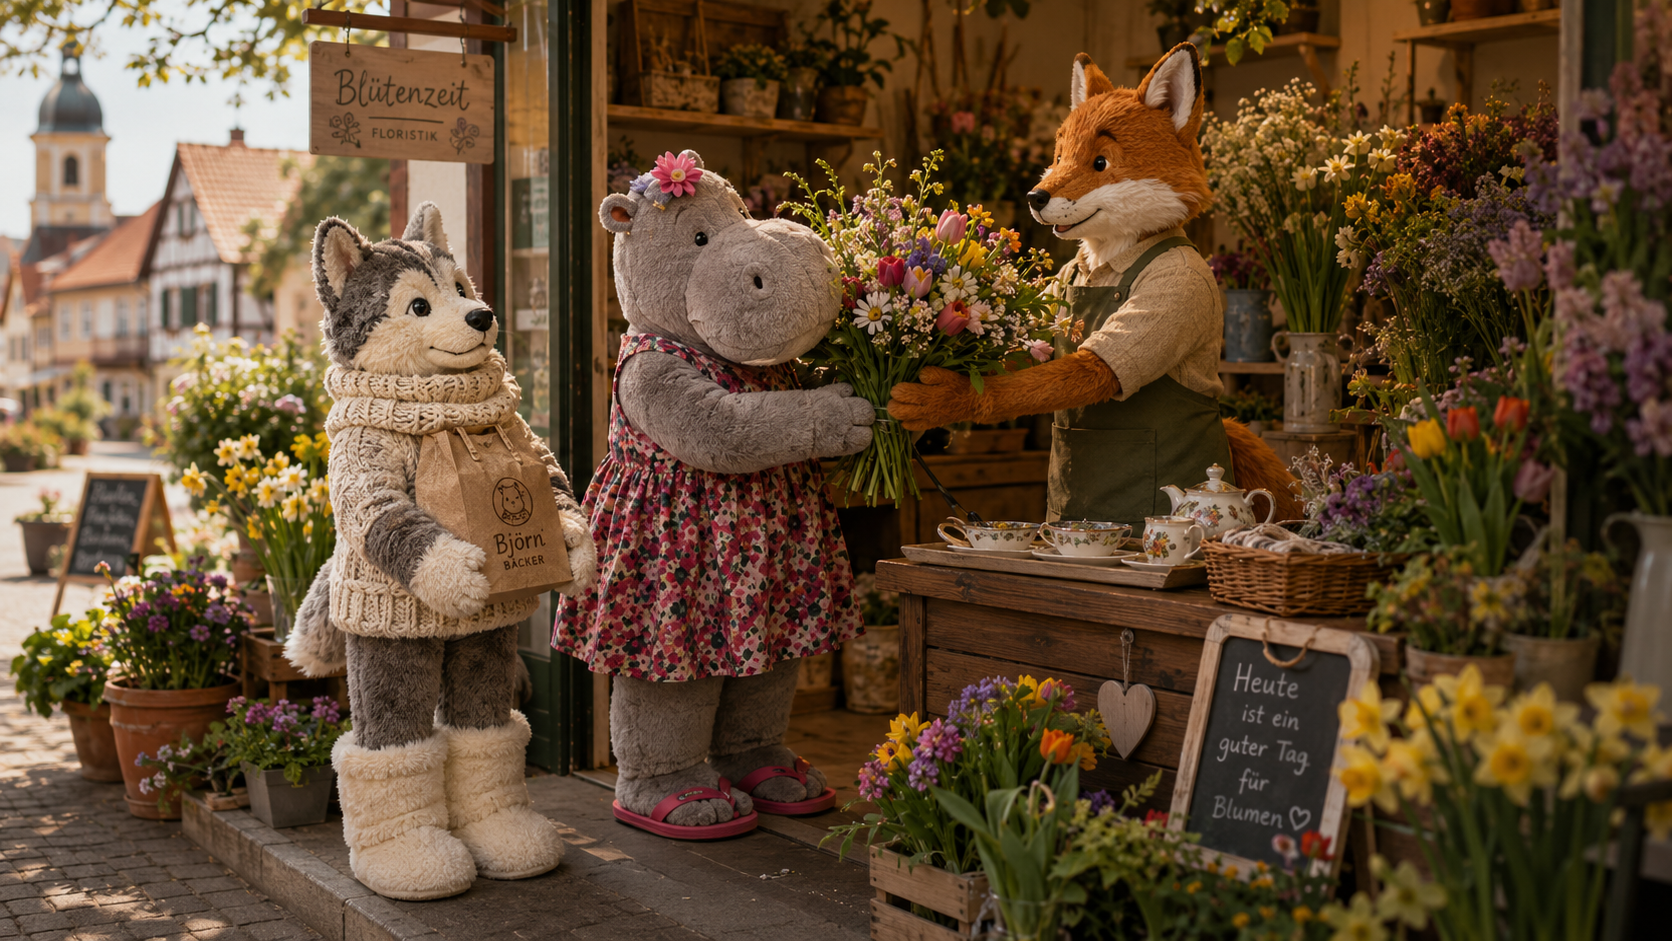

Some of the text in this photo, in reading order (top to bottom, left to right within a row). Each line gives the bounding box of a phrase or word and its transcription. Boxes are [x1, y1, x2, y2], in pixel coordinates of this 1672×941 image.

[333, 68, 470, 111] Blütenzeit
[371, 127, 438, 142] FLORISTIK
[1233, 662, 1299, 699] Heute
[1241, 704, 1300, 731] ist ein
[1216, 734, 1310, 776] guter Tag
[1238, 767, 1270, 795] für
[1212, 795, 1283, 829] Blumen
